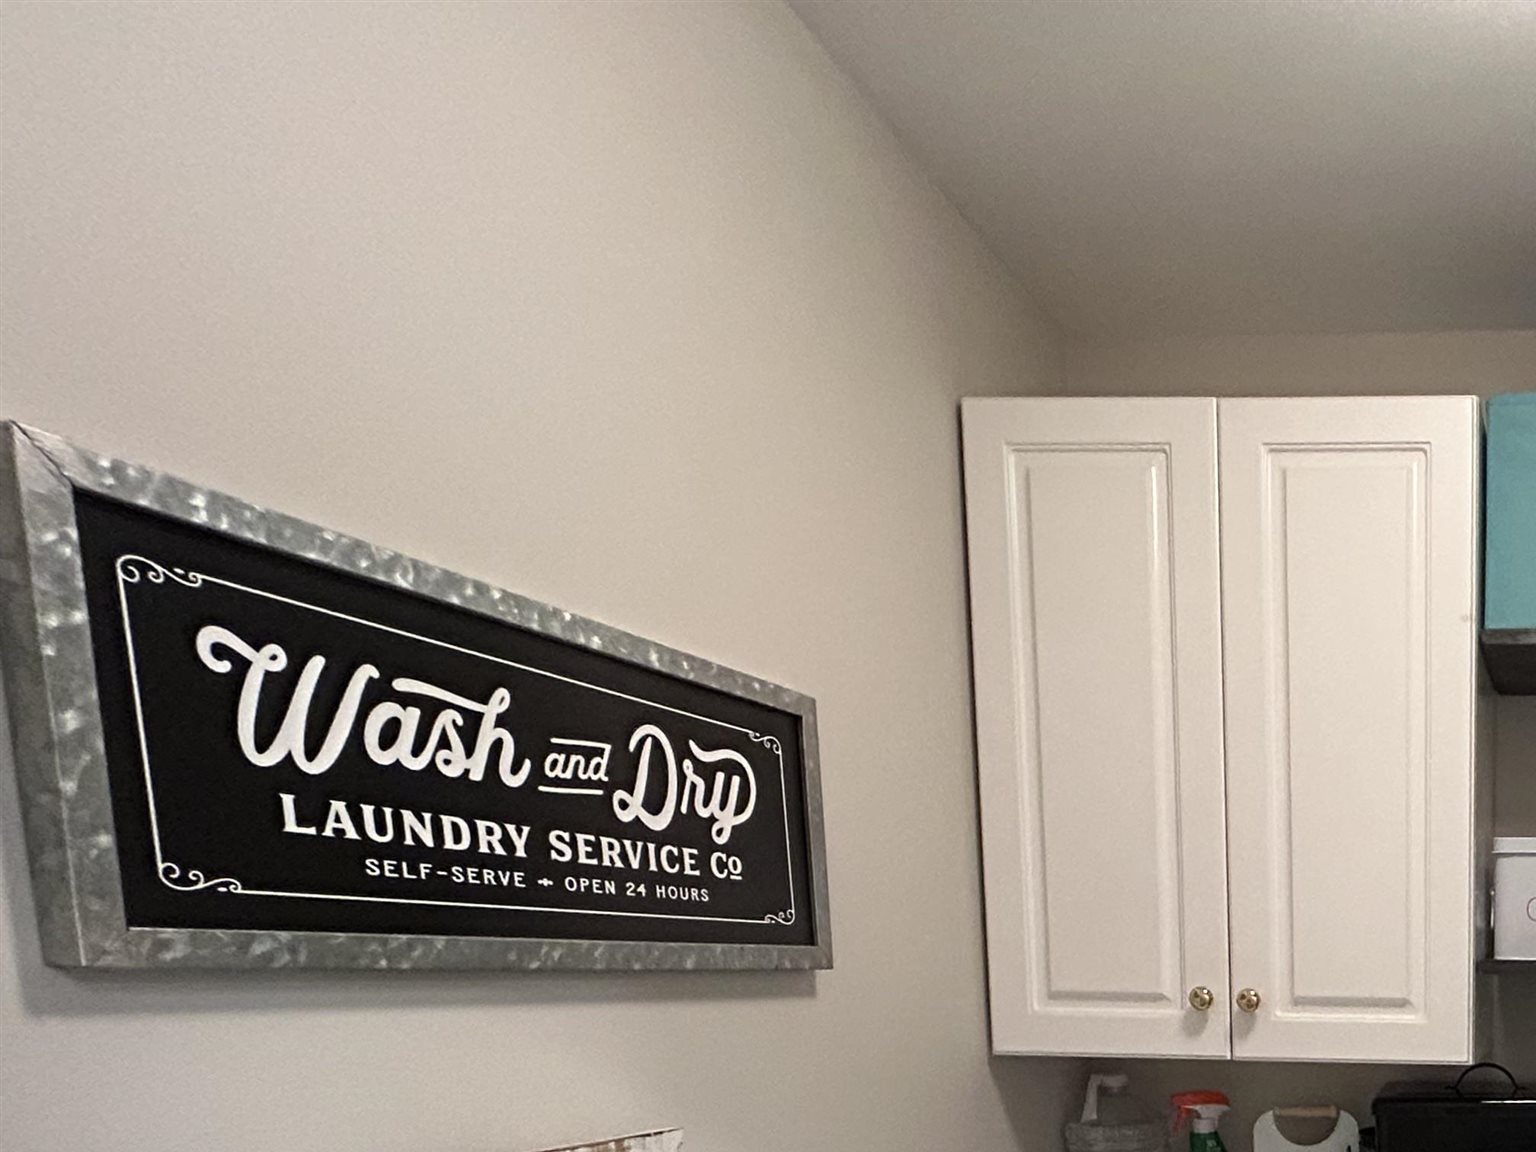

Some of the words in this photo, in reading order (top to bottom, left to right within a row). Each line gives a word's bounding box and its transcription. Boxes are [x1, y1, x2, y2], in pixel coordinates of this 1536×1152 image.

[195, 625, 532, 788] Wash
[542, 737, 612, 784] and
[612, 724, 757, 845] Dry
[279, 793, 531, 858] LAUNDRY
[548, 829, 701, 877] SERVICE
[364, 858, 527, 888] SELF-SERVE
[564, 876, 616, 896] OPEN
[625, 882, 648, 898] 24
[655, 884, 710, 902] HOURS
